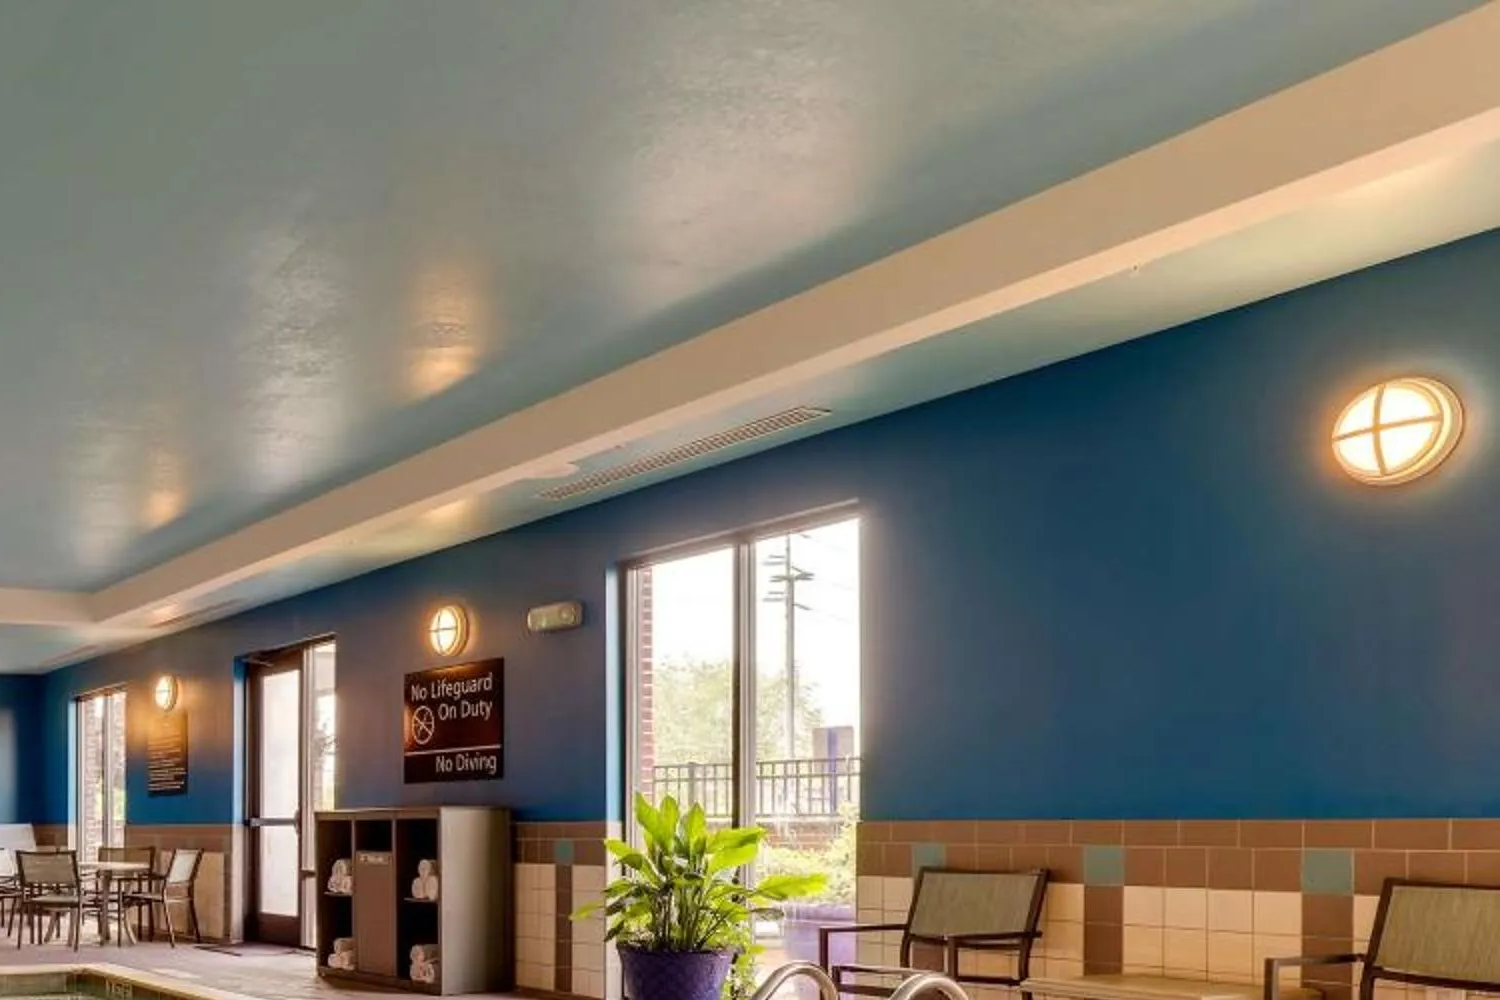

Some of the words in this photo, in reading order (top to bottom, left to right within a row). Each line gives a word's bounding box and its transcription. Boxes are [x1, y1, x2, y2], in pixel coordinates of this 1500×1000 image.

[411, 683, 428, 701] No
[431, 672, 493, 701] Lifeguard
[438, 703, 457, 720] On
[461, 700, 493, 720] Duty
[435, 755, 453, 773] No
[455, 752, 497, 775] Diving
